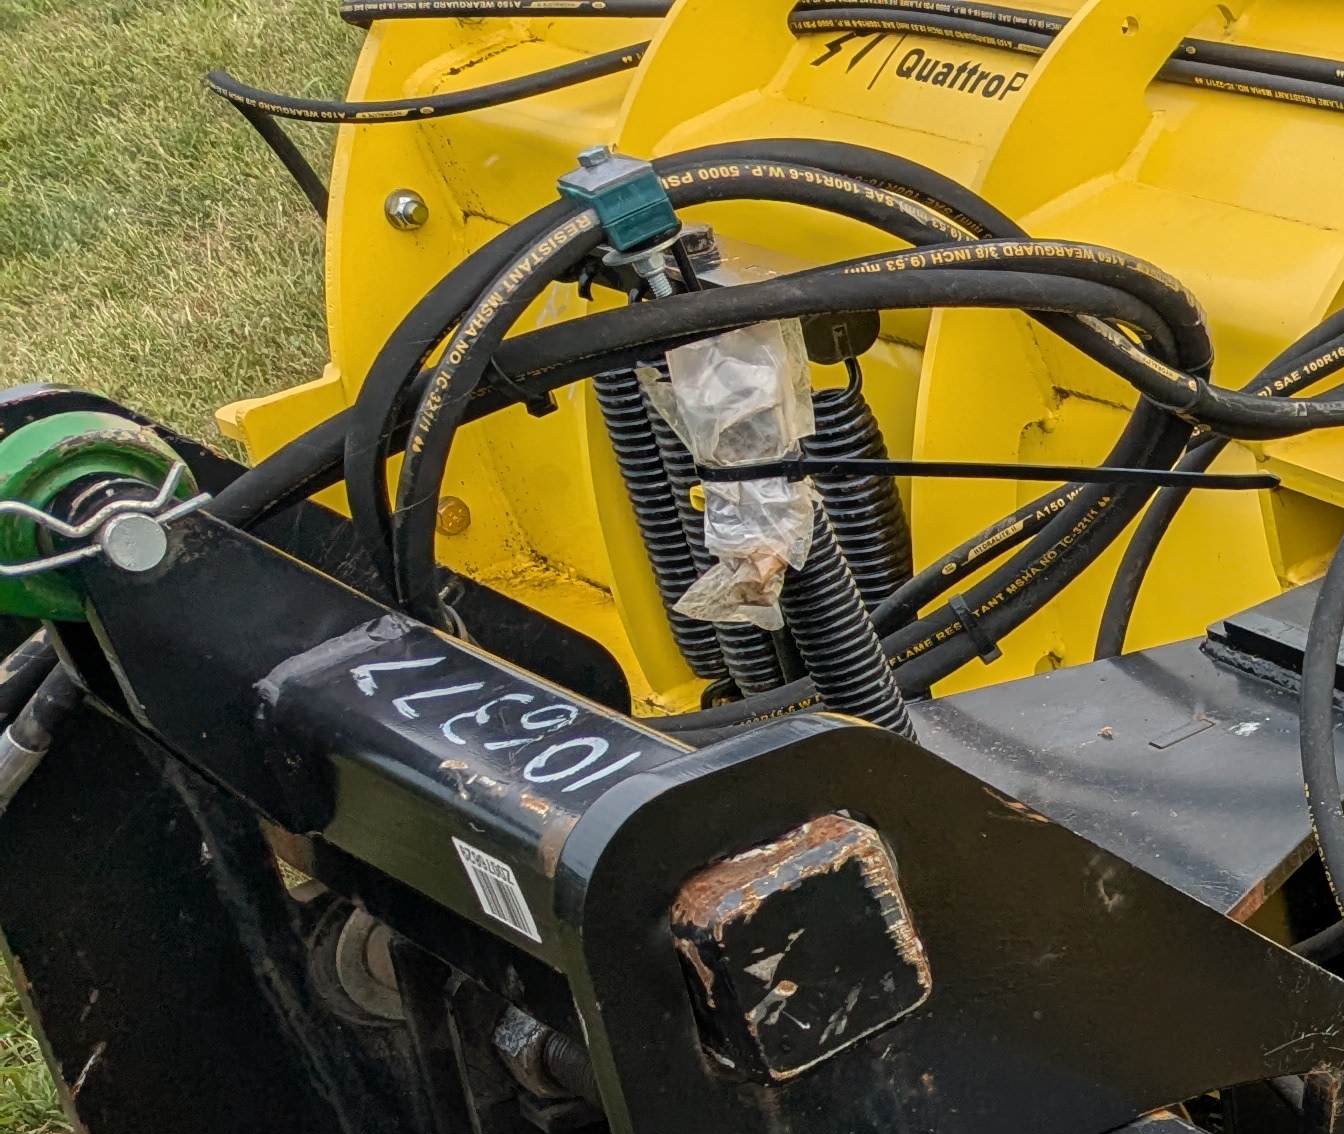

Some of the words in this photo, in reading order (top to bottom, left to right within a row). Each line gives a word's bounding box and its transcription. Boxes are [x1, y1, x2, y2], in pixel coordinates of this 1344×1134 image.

[698, 165, 740, 181] 5000
[790, 169, 859, 194] 100R16-6
[865, 186, 895, 208] SAE
[501, 213, 592, 293] RESISTANT
[932, 249, 971, 266] INCH
[975, 244, 998, 260] 3/8
[1003, 244, 1097, 261] WEARGUARD
[1098, 251, 1126, 267] A150
[886, 256, 926, 272] (9.53
[464, 291, 504, 338] MSHA
[1274, 370, 1302, 391] SAE
[1035, 497, 1066, 521] A150
[889, 638, 934, 668] FLAME
[1005, 566, 1042, 595] MSHA
